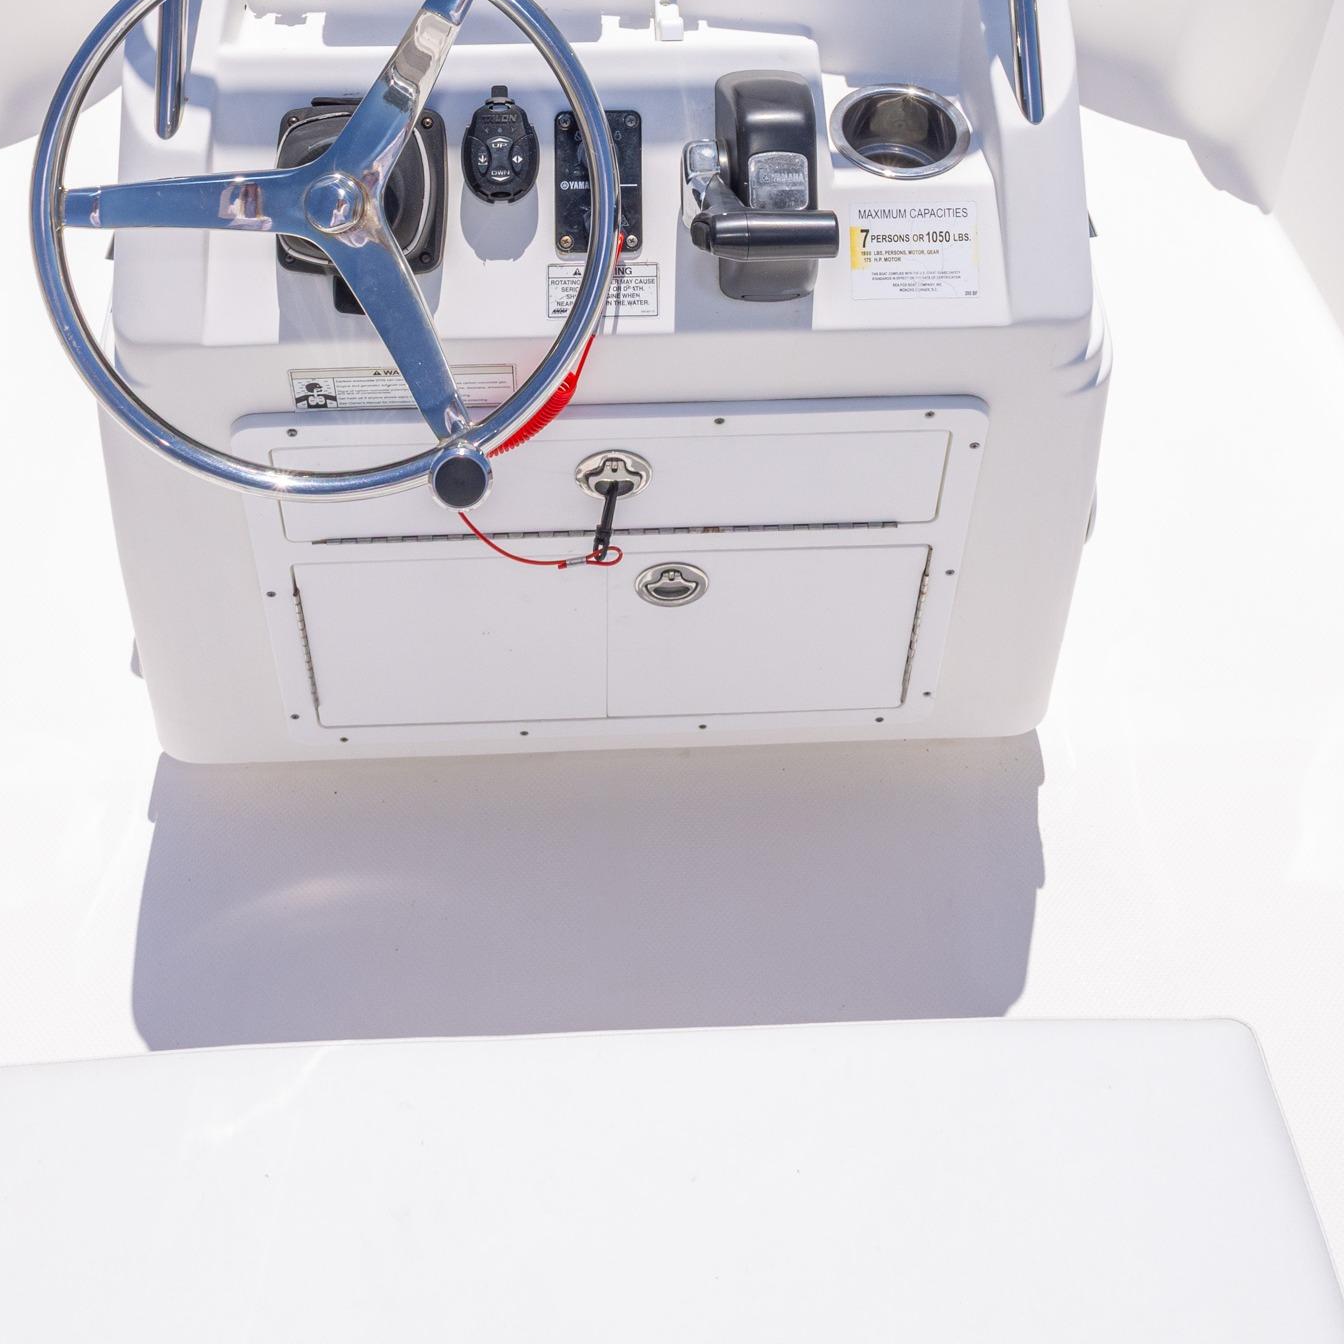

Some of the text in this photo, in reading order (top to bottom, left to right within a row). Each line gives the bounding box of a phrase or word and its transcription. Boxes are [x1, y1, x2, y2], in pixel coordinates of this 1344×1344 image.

[570, 181, 591, 190] YAMA
[858, 207, 968, 219] MAXIMUM CAPACITIES
[860, 229, 971, 248] 7 PERSONS OR 1050 LBS.
